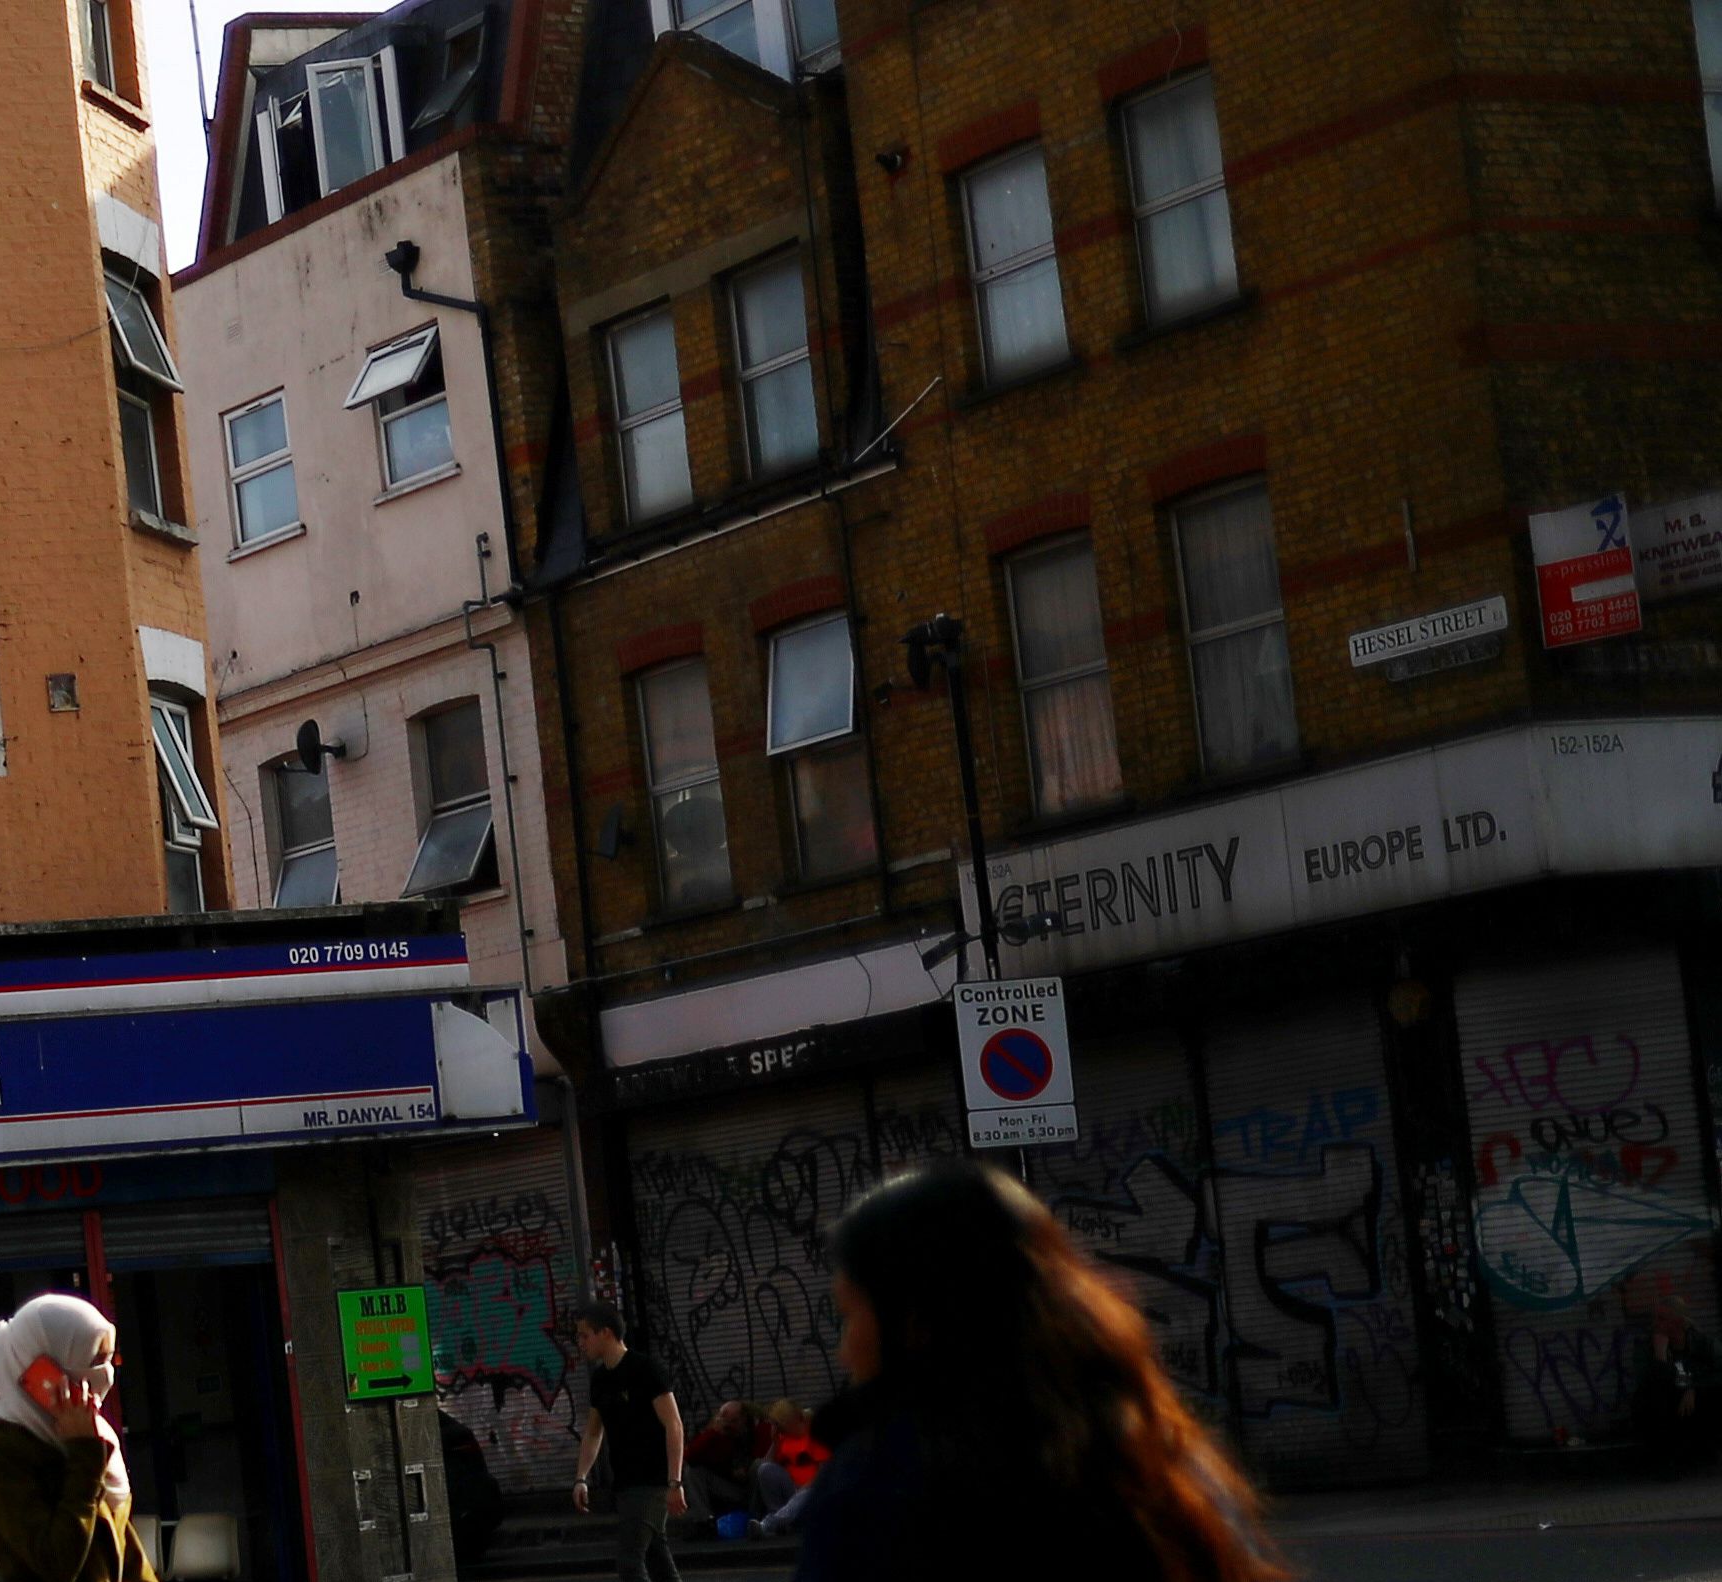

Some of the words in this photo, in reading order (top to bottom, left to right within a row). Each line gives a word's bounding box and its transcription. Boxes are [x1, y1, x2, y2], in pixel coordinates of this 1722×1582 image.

[1549, 609, 1572, 624] 020
[1352, 627, 1417, 657] HESSEL
[1419, 606, 1487, 640] STREET
[1551, 622, 1573, 636] 020
[1551, 733, 1625, 755] 152-152A
[1305, 826, 1424, 884] EUROPE
[1443, 811, 1508, 853] LTD.
[288, 947, 319, 964] 020
[323, 943, 364, 963] 7709
[368, 941, 409, 960] 0145
[960, 982, 1058, 1003] Controlled
[976, 1003, 1045, 1026] ZONE
[303, 1111, 333, 1128] MR.
[338, 1106, 402, 1126] DANYAL
[408, 1103, 435, 1121] 154
[998, 1115, 1023, 1127] Mon
[1031, 1113, 1047, 1125] Fri
[973, 1130, 1001, 1142] 8.30
[1028, 1126, 1055, 1138] 5.30
